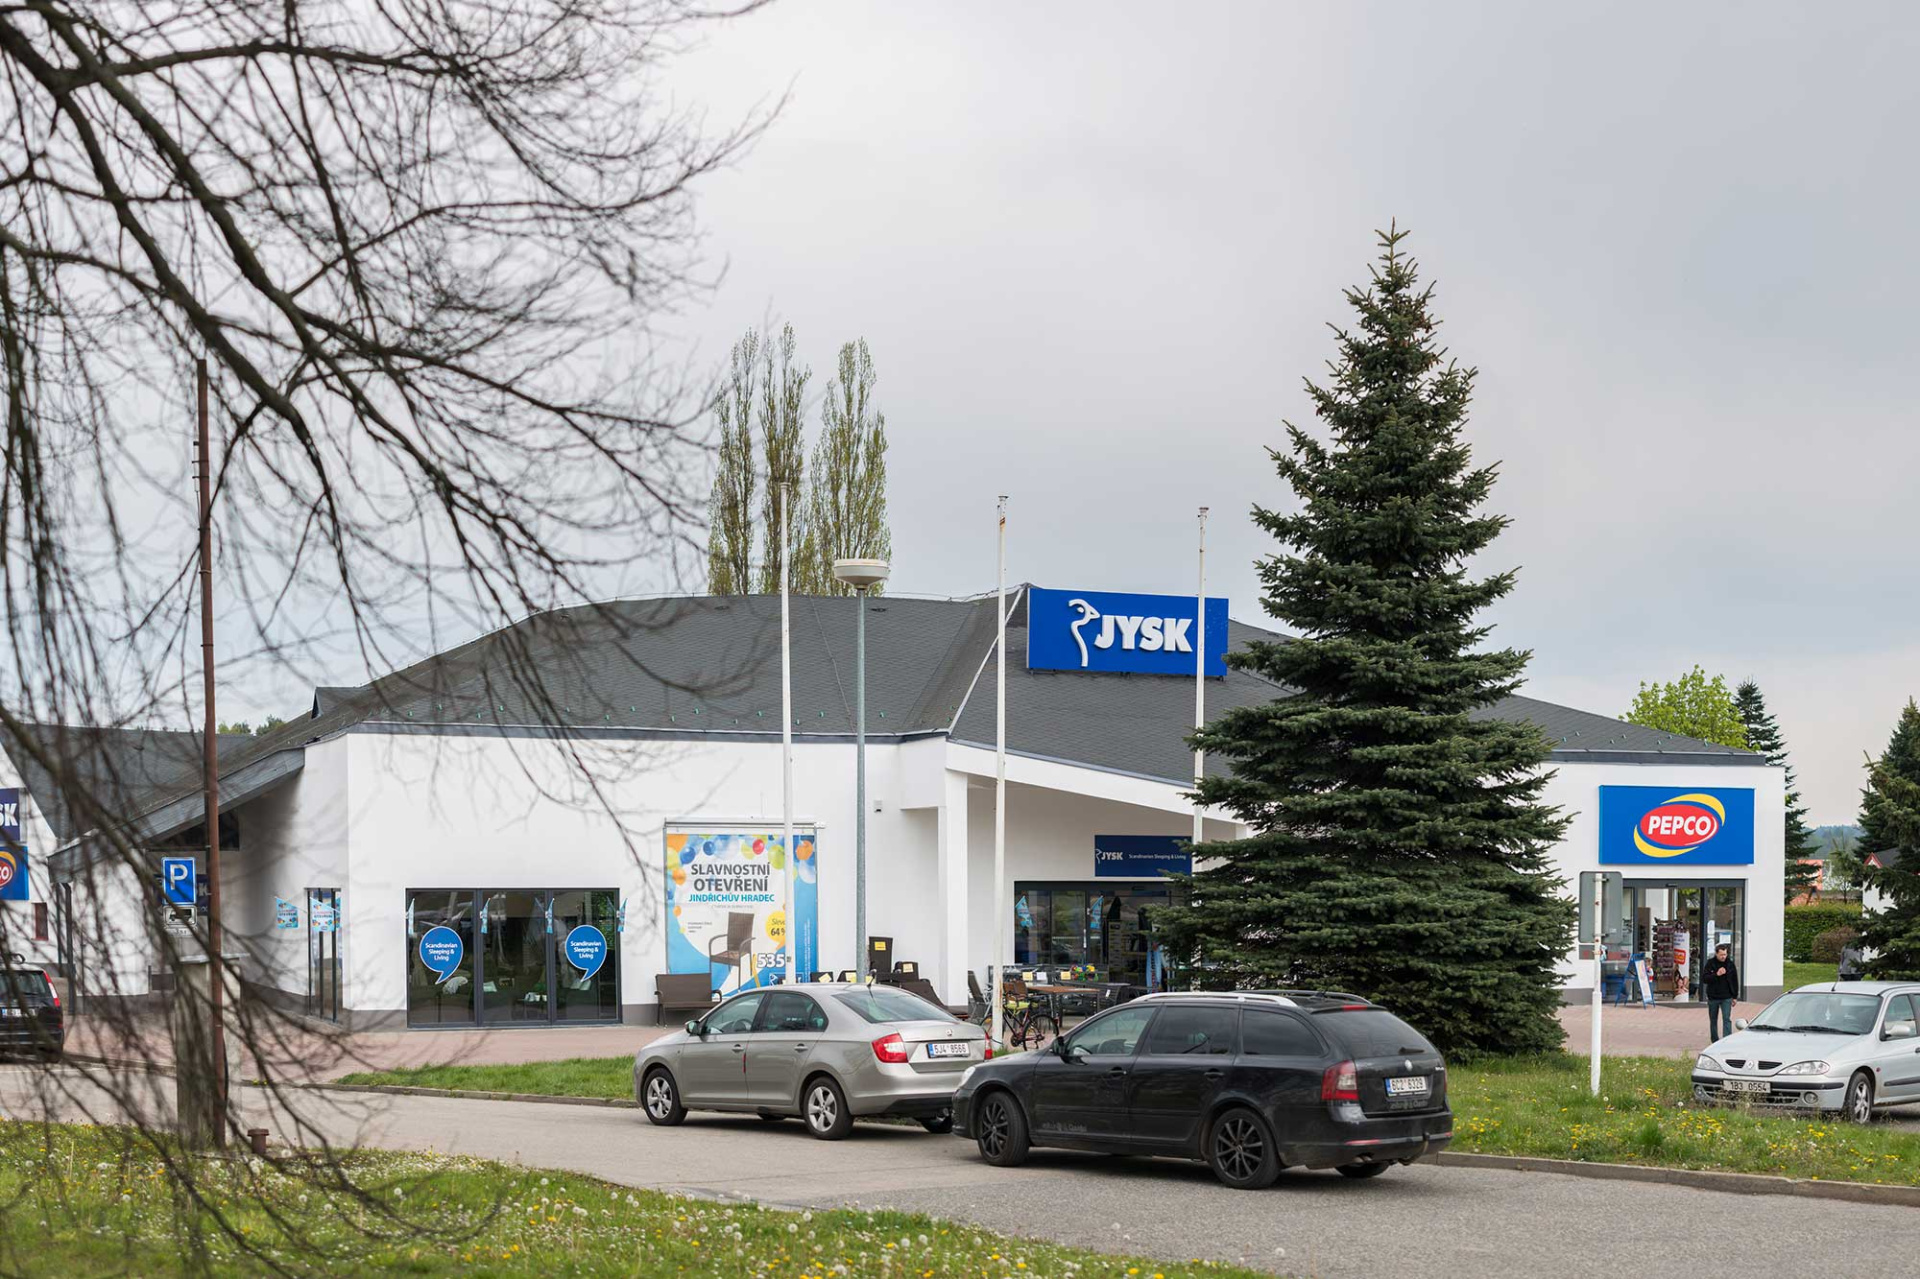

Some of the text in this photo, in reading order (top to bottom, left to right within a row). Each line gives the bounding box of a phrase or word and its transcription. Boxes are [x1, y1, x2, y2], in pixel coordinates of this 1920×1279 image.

[1094, 615, 1193, 652] JYSK
[1648, 815, 1712, 836] PEPCO
[1101, 852, 1123, 861] JYSK
[691, 862, 771, 876] SLAVNOSTNÍ
[169, 864, 189, 890] P
[694, 876, 768, 892] OTEVŘENÍ
[689, 892, 775, 902] JINDŘICHŮV HRADEC
[771, 927, 780, 936] 64
[757, 953, 785, 968] 535
